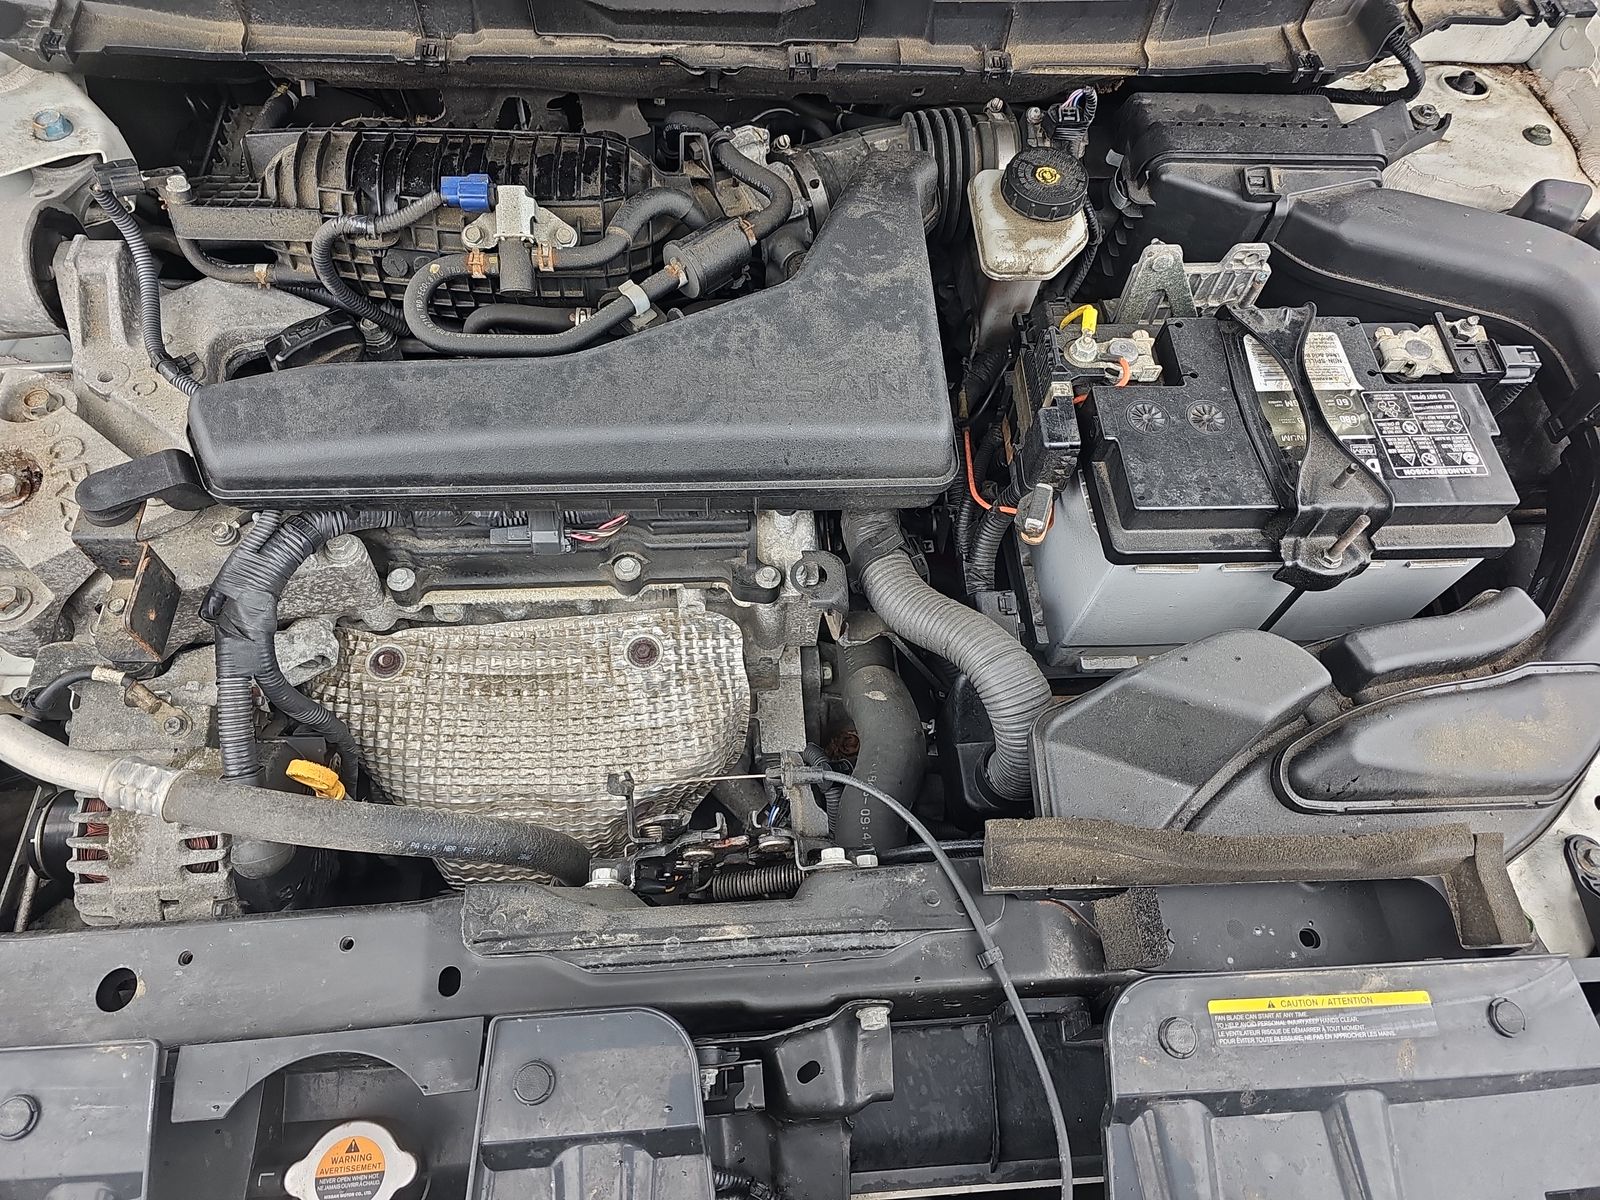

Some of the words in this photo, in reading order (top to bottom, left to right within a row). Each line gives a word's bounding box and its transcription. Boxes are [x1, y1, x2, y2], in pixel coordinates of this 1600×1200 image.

[1336, 398, 1349, 406] 60
[1339, 415, 1357, 423] 680
[1280, 999, 1318, 1008] CAUTION
[1327, 996, 1374, 1006] ATTENTION
[1320, 1016, 1339, 1024] HANDS
[1226, 1028, 1261, 1037] VENTILATEUR
[1291, 1025, 1321, 1033] DÉMARRER
[1219, 1037, 1236, 1045] POUR
[1236, 1035, 1255, 1044] ÉVITER
[331, 1153, 373, 1164] WARNING
[319, 1162, 382, 1175] AVERTISSEMENT
